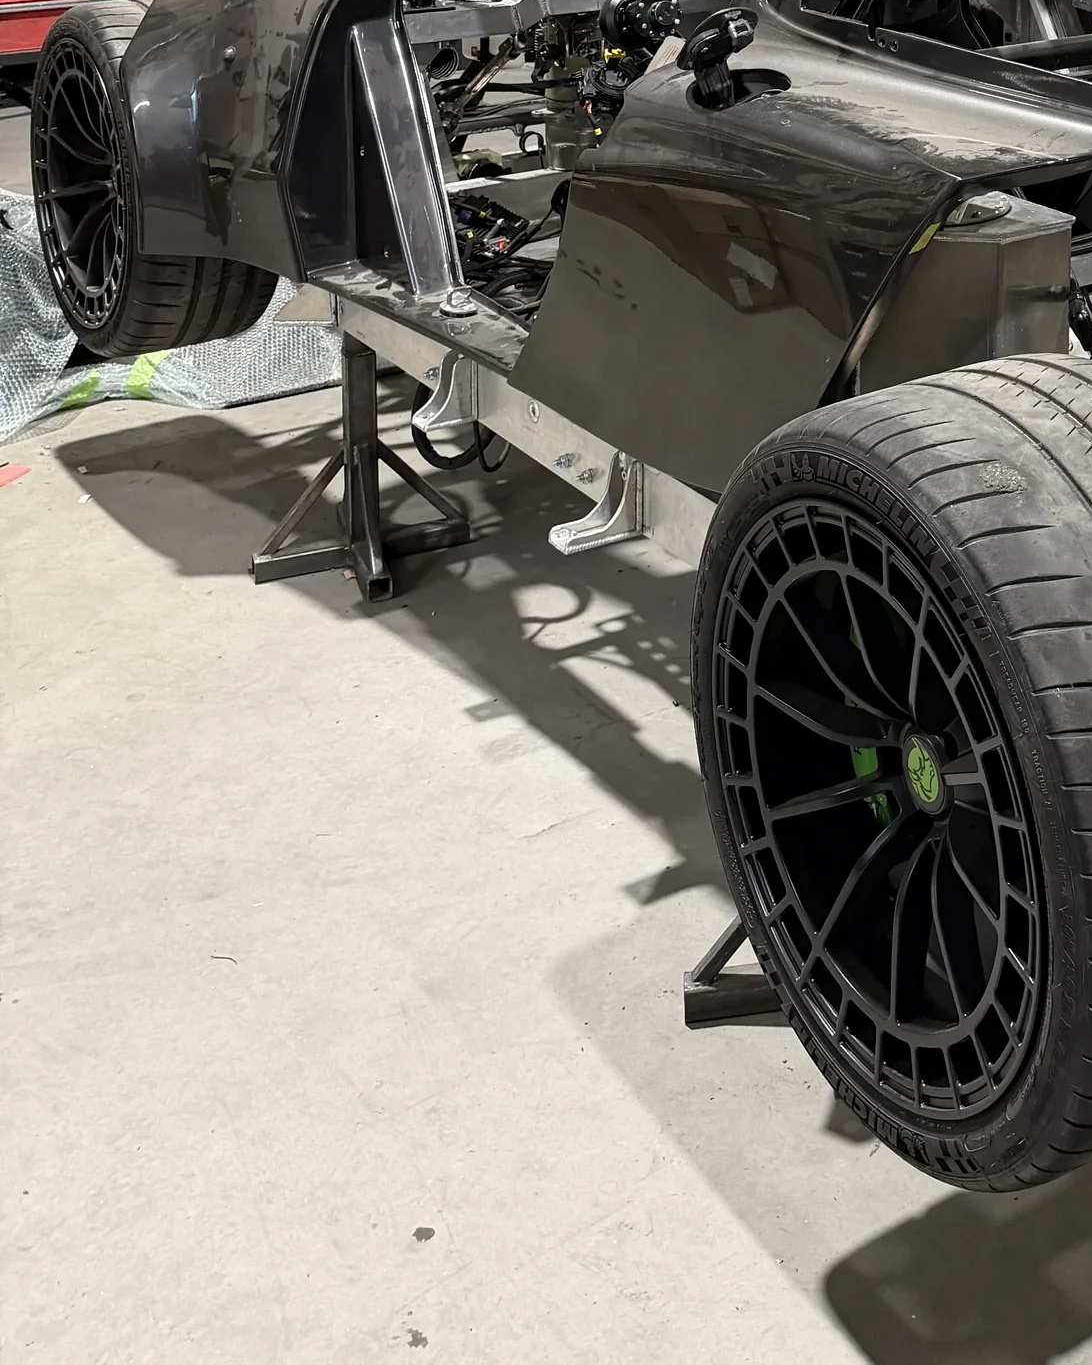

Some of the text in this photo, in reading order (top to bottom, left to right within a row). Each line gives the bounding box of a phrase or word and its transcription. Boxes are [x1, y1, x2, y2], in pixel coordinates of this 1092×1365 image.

[816, 456, 937, 557] MICHELIN
[999, 660, 1023, 714] TREADWEAR
[1031, 748, 1049, 796] TRACTION
[788, 1009, 901, 1149] MICHELIN
